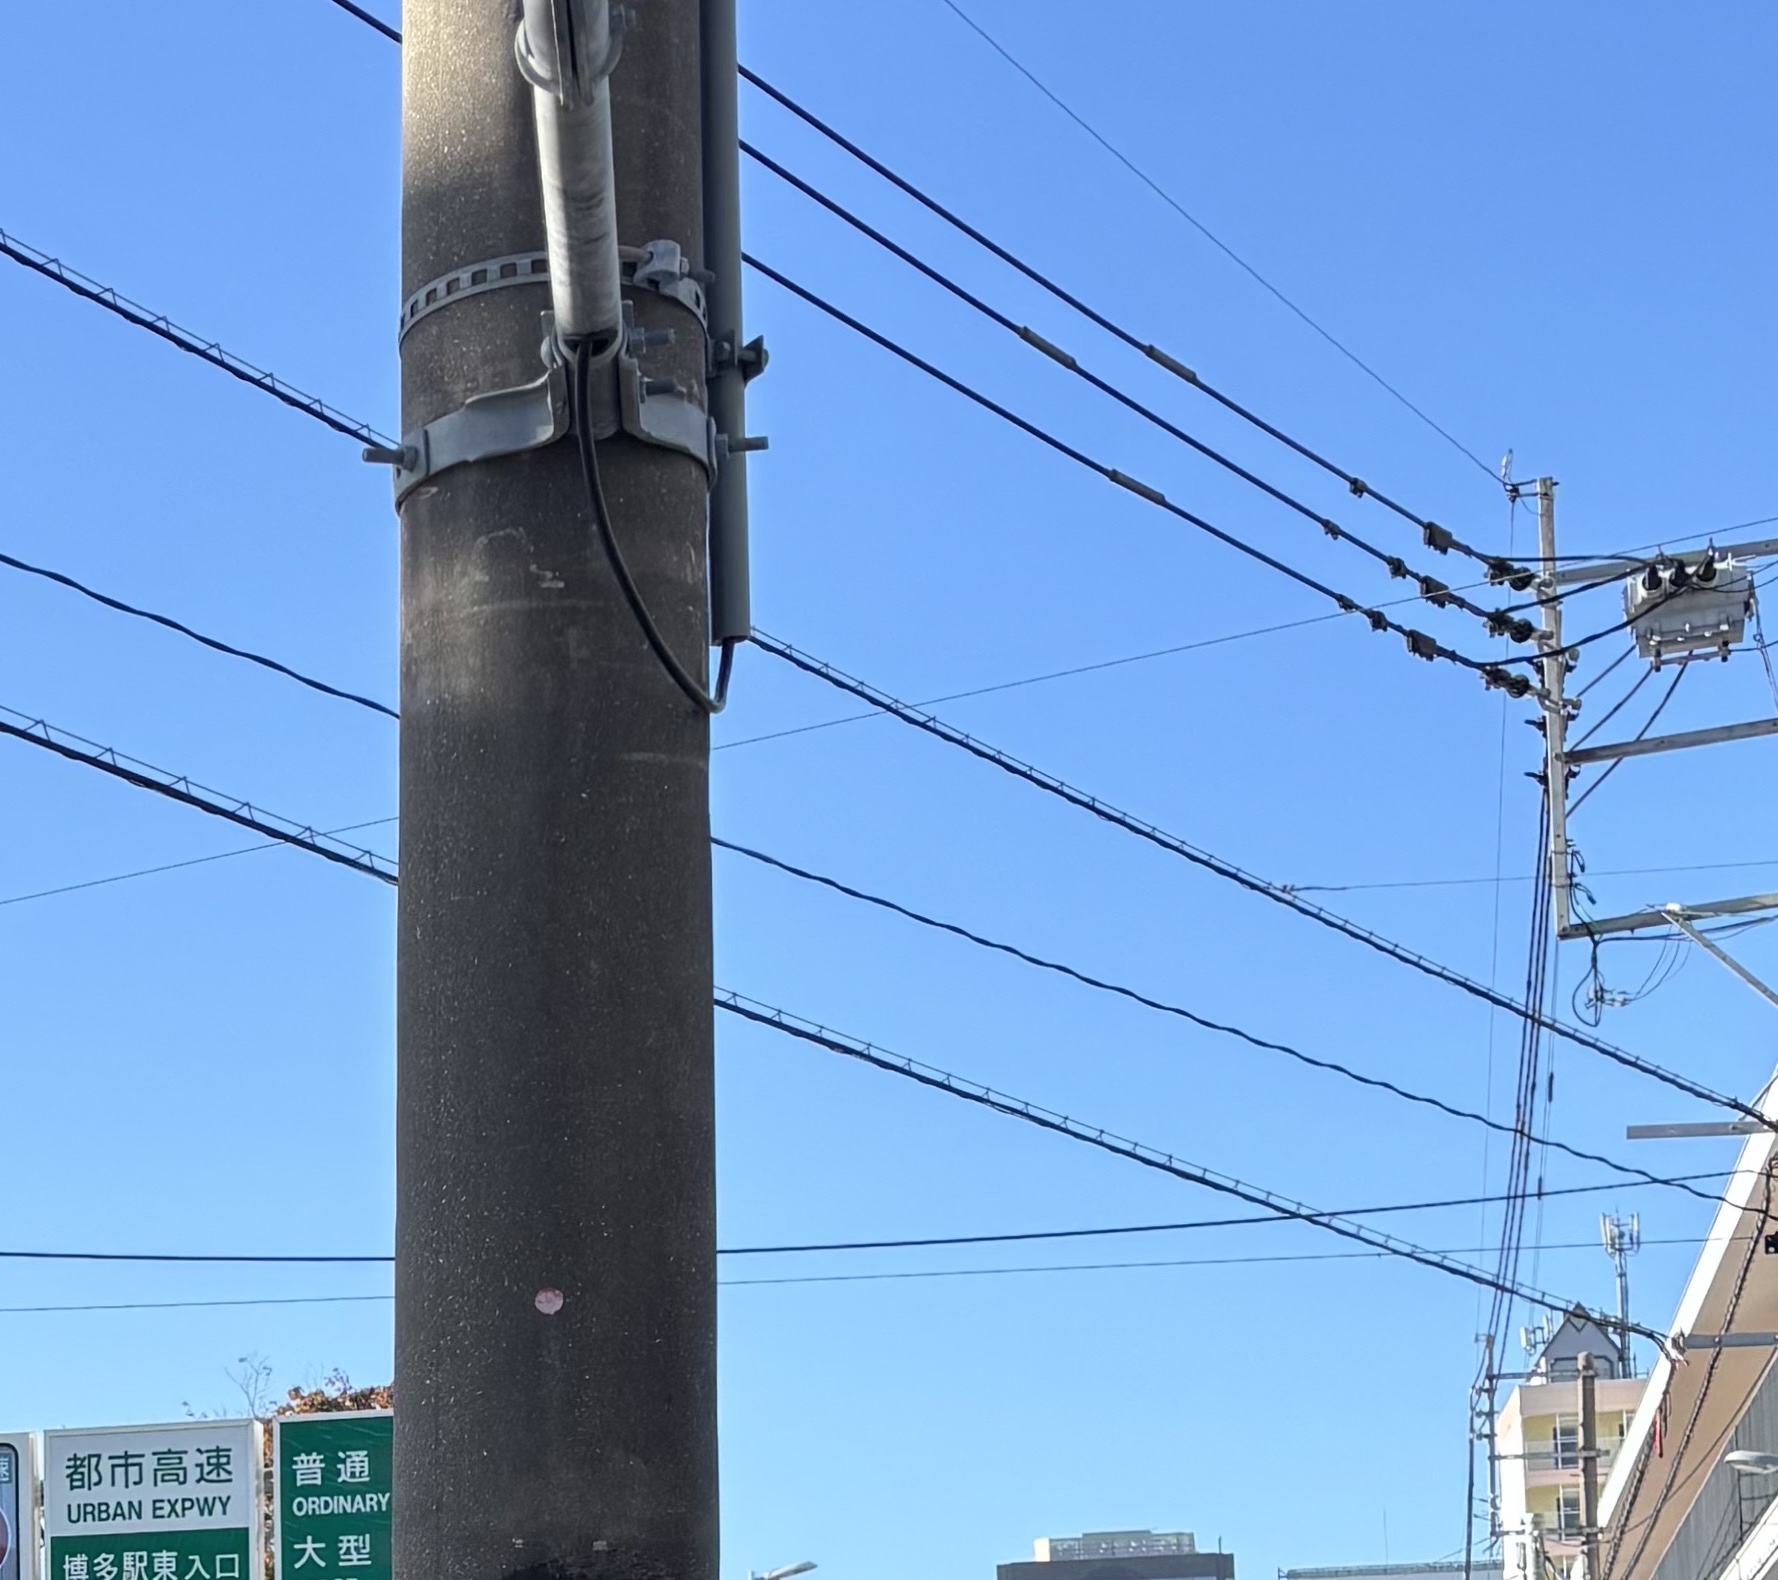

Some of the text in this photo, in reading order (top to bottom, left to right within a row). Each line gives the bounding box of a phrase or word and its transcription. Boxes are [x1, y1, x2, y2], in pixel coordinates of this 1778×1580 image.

[65, 1445, 234, 1492] 都市高速
[291, 1450, 371, 1487] 普通
[67, 1495, 232, 1524] URBAN EXPWY
[292, 1492, 391, 1517] ORDINARY
[293, 1533, 372, 1569] 大型
